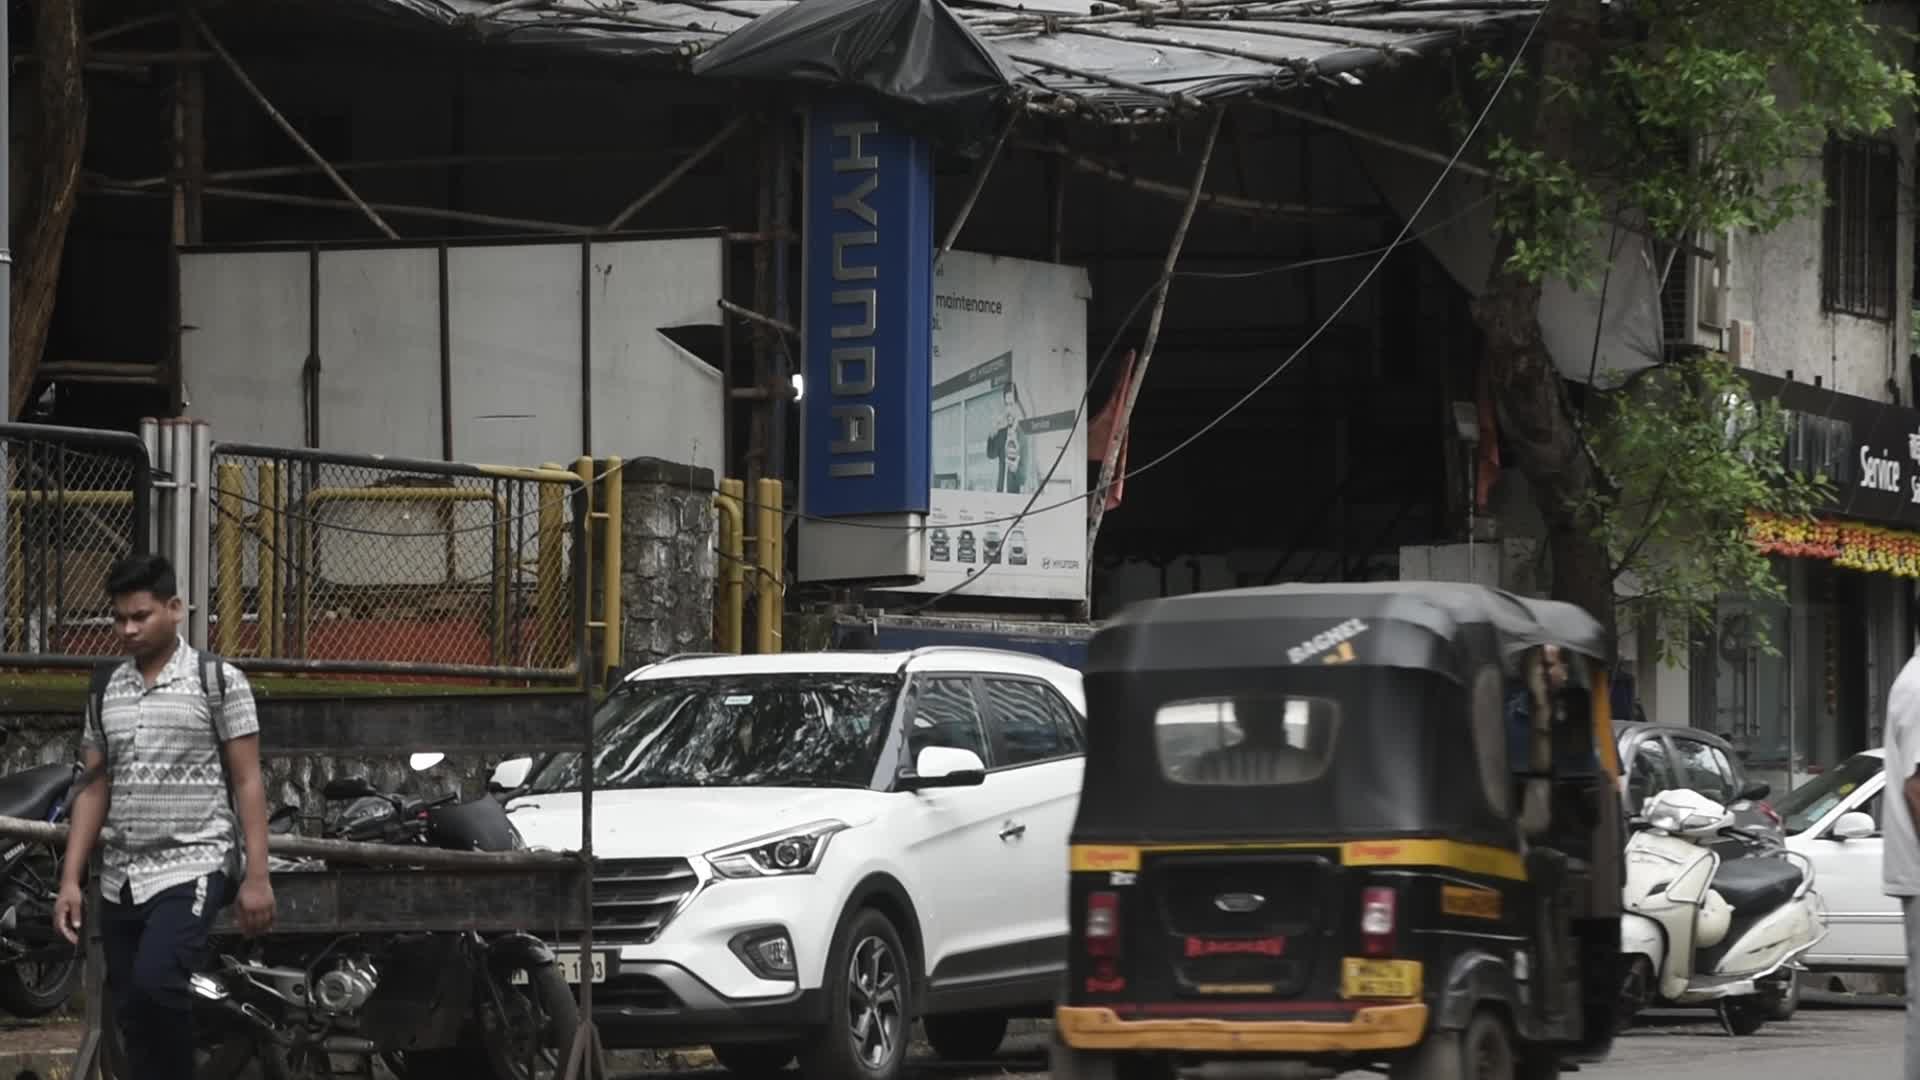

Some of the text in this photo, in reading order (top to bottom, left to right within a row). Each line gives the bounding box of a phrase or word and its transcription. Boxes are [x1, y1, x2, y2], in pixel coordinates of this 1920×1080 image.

[831, 120, 878, 478] HYUNDAI
[935, 291, 1003, 315] maintenance
[1860, 445, 1900, 492] Service
